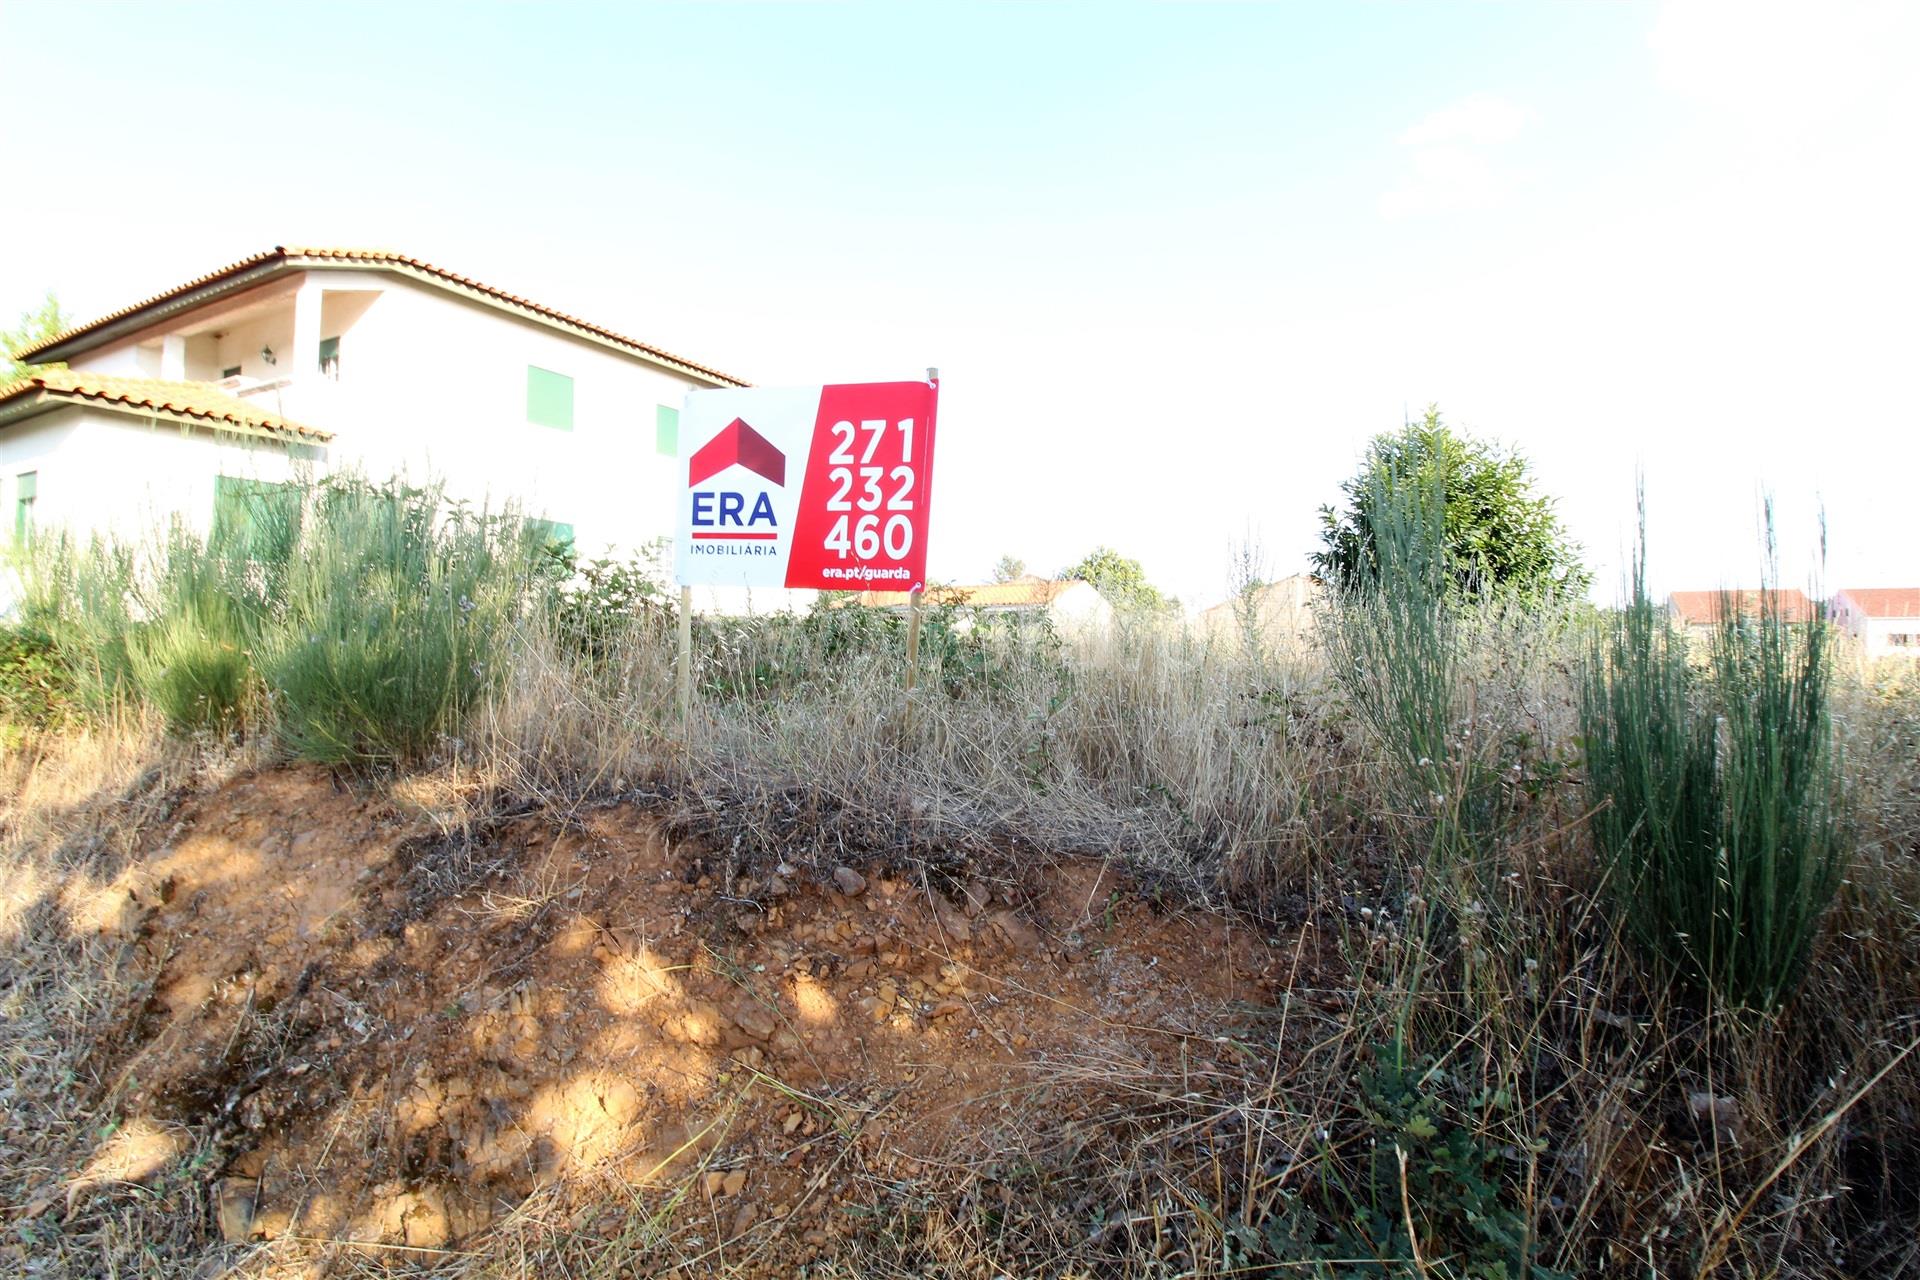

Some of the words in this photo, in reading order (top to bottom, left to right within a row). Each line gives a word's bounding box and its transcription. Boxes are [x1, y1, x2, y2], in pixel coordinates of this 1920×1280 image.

[828, 418, 914, 465] 271
[691, 491, 778, 527] ERA
[826, 465, 915, 512] 232
[823, 514, 914, 560] 460
[822, 564, 911, 581] era.pt/guarda
